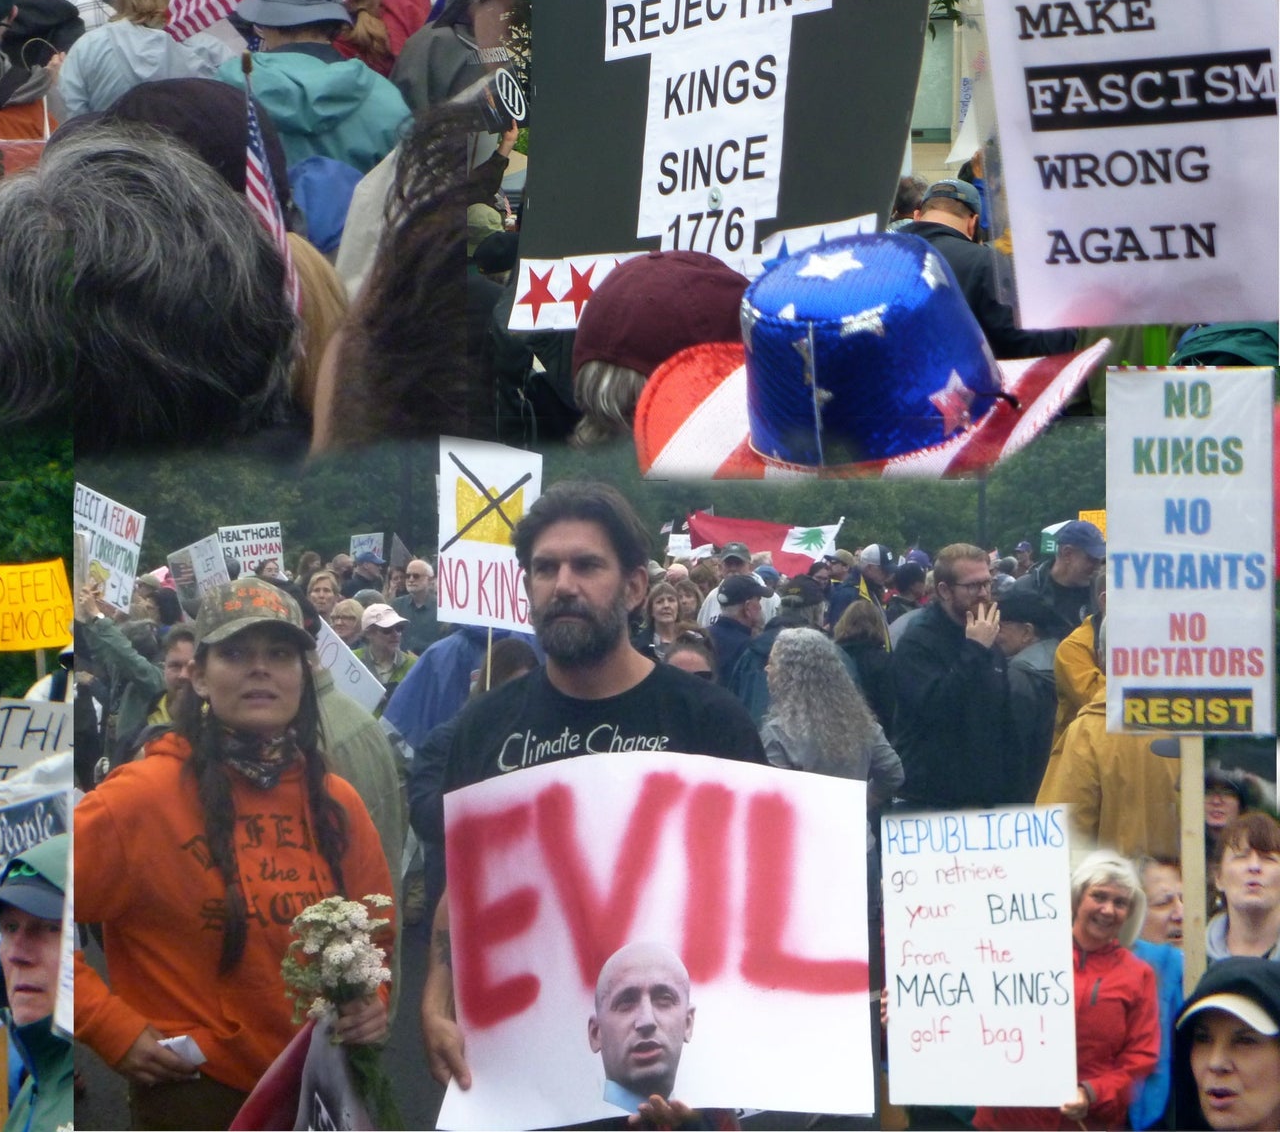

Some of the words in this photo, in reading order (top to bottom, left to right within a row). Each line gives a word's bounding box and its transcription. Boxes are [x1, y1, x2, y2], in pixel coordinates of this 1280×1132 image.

[664, 54, 778, 120] KINGS
[1028, 63, 1279, 116] FASCISM
[657, 134, 768, 196] SINCE
[1034, 145, 1210, 190] WRONG
[666, 206, 746, 256] 1776
[1045, 222, 1217, 266] AGAIN
[498, 731, 580, 772] Climate
[585, 725, 670, 753] Change
[885, 810, 1067, 854] REPUBLICANS
[448, 772, 869, 1030] EVIL
[988, 895, 1058, 924] BALLS
[896, 974, 972, 1008] MAGA
